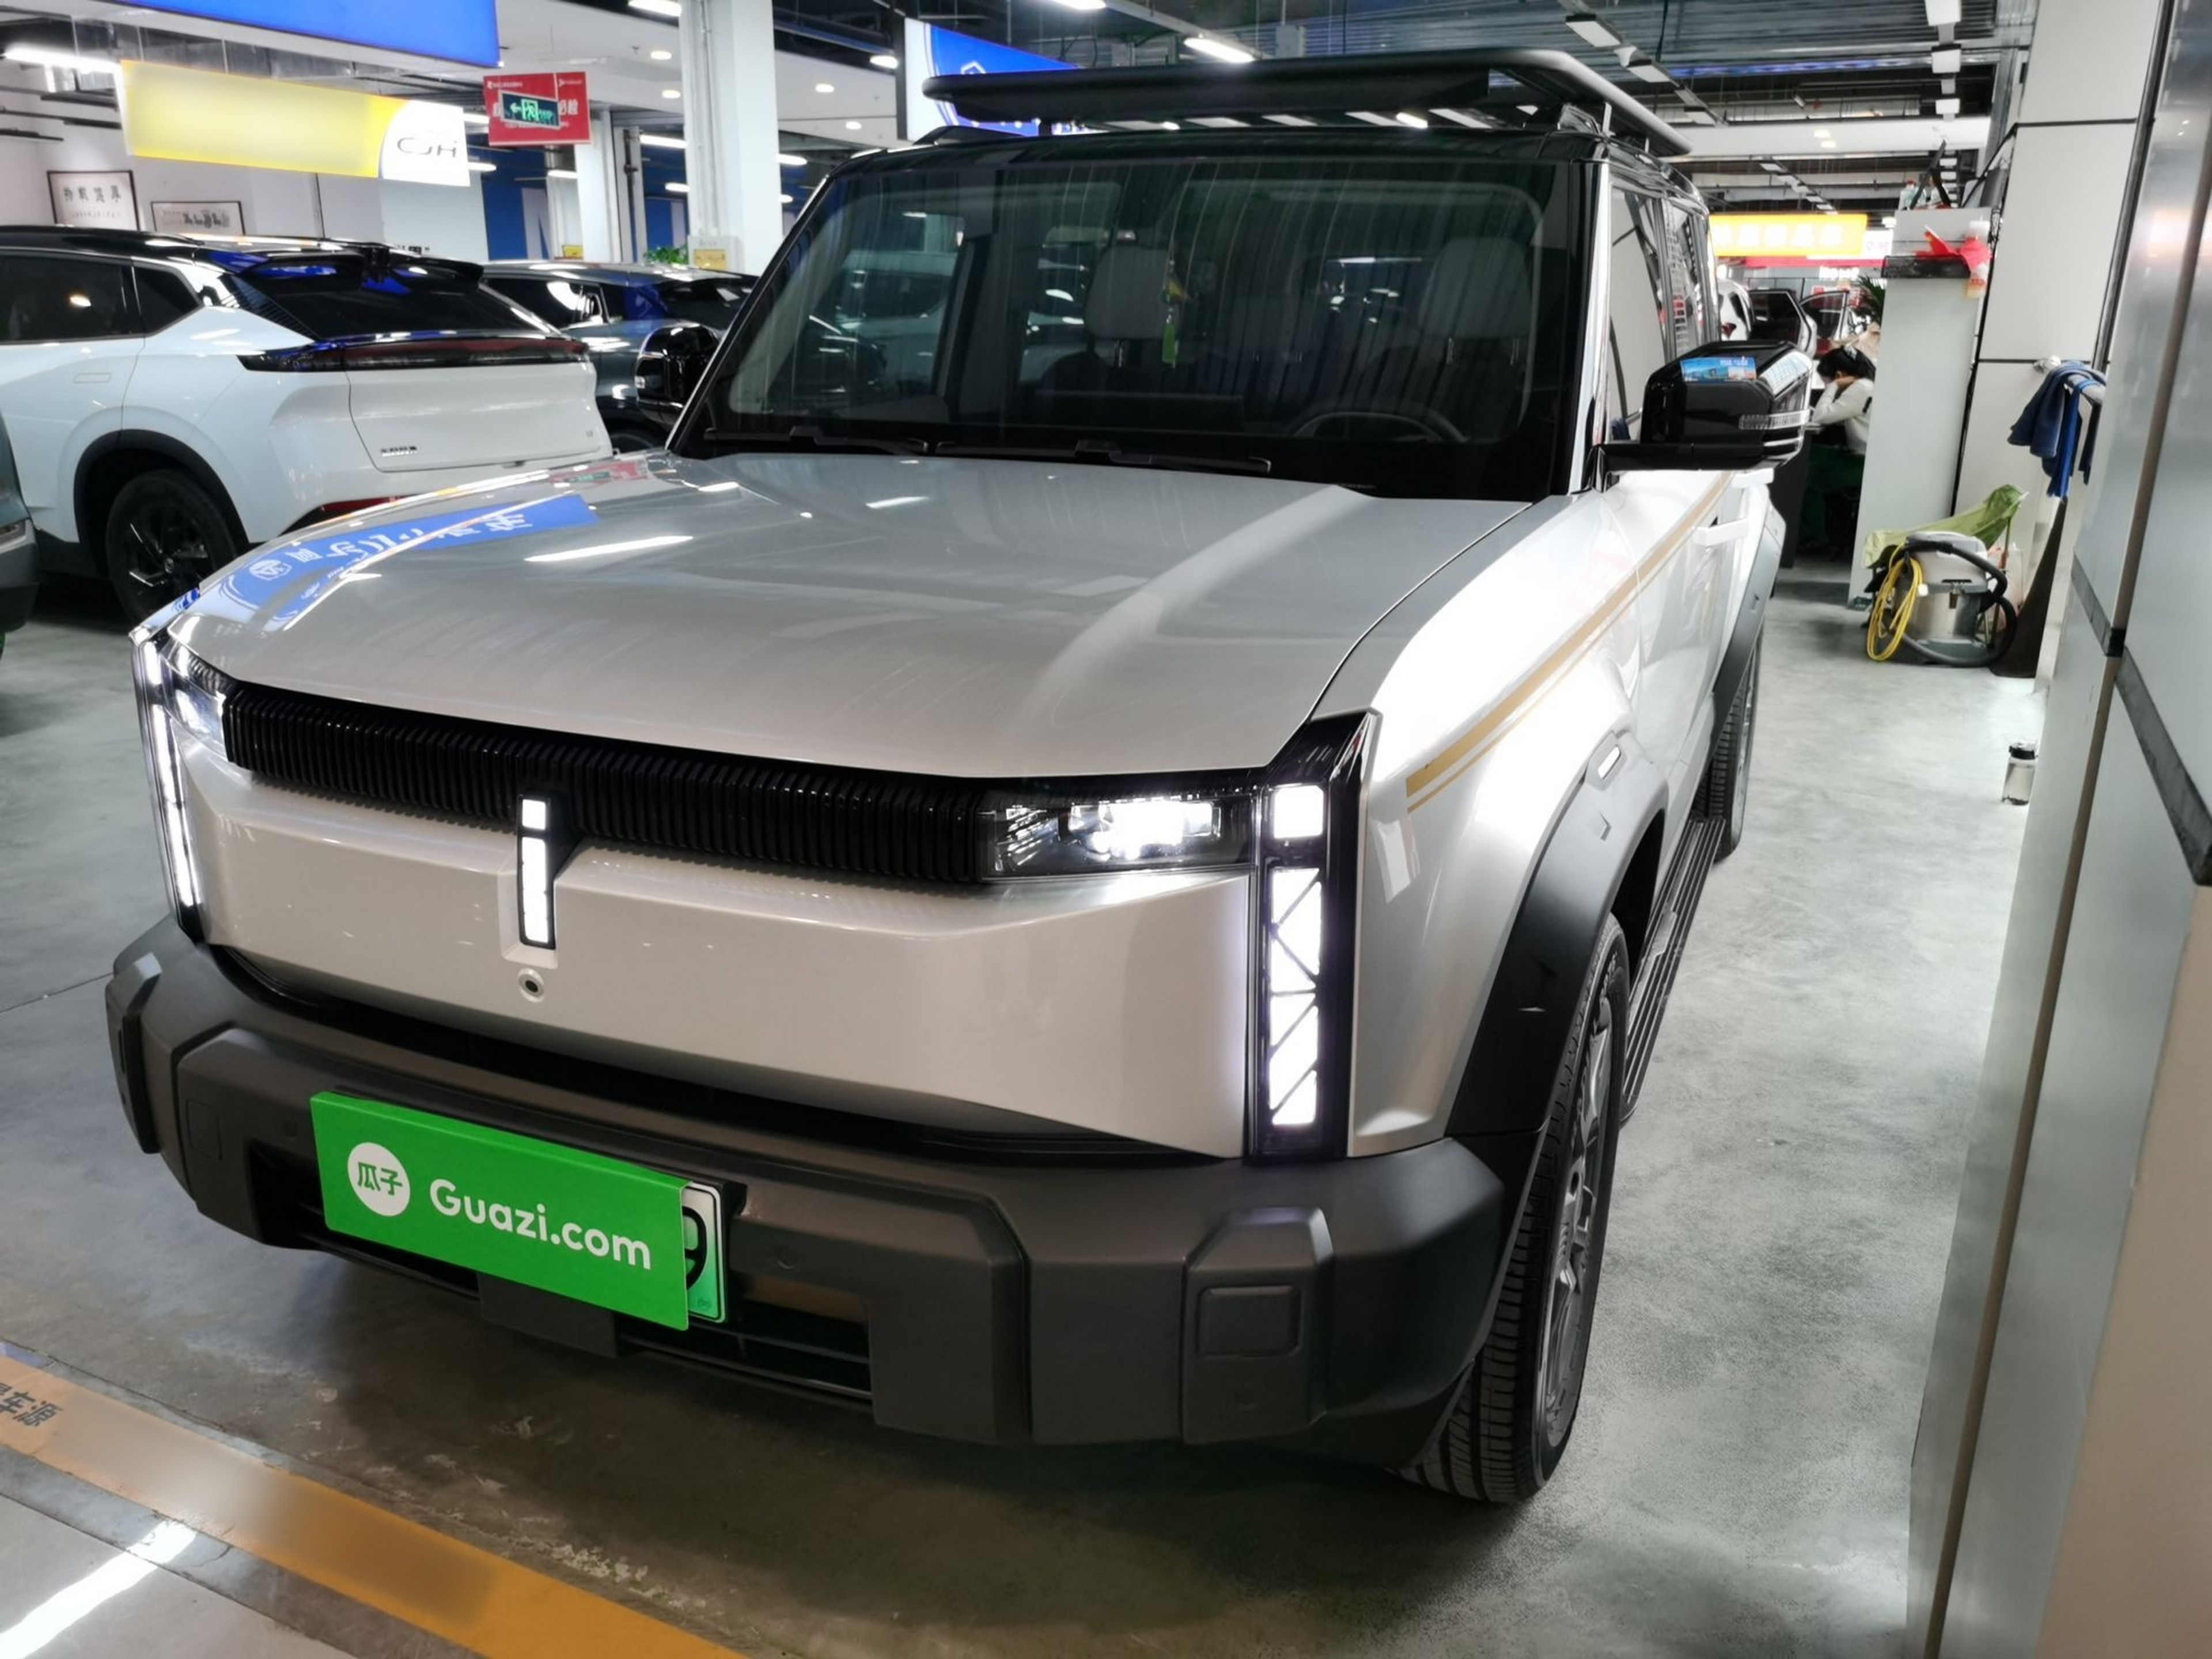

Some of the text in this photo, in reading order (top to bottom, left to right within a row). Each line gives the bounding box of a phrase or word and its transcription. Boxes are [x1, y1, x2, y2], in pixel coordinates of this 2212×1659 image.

[358, 1162, 403, 1196] 瓜子
[430, 1179, 651, 1270] Guazi.com
[0, 1383, 64, 1427] 车源
